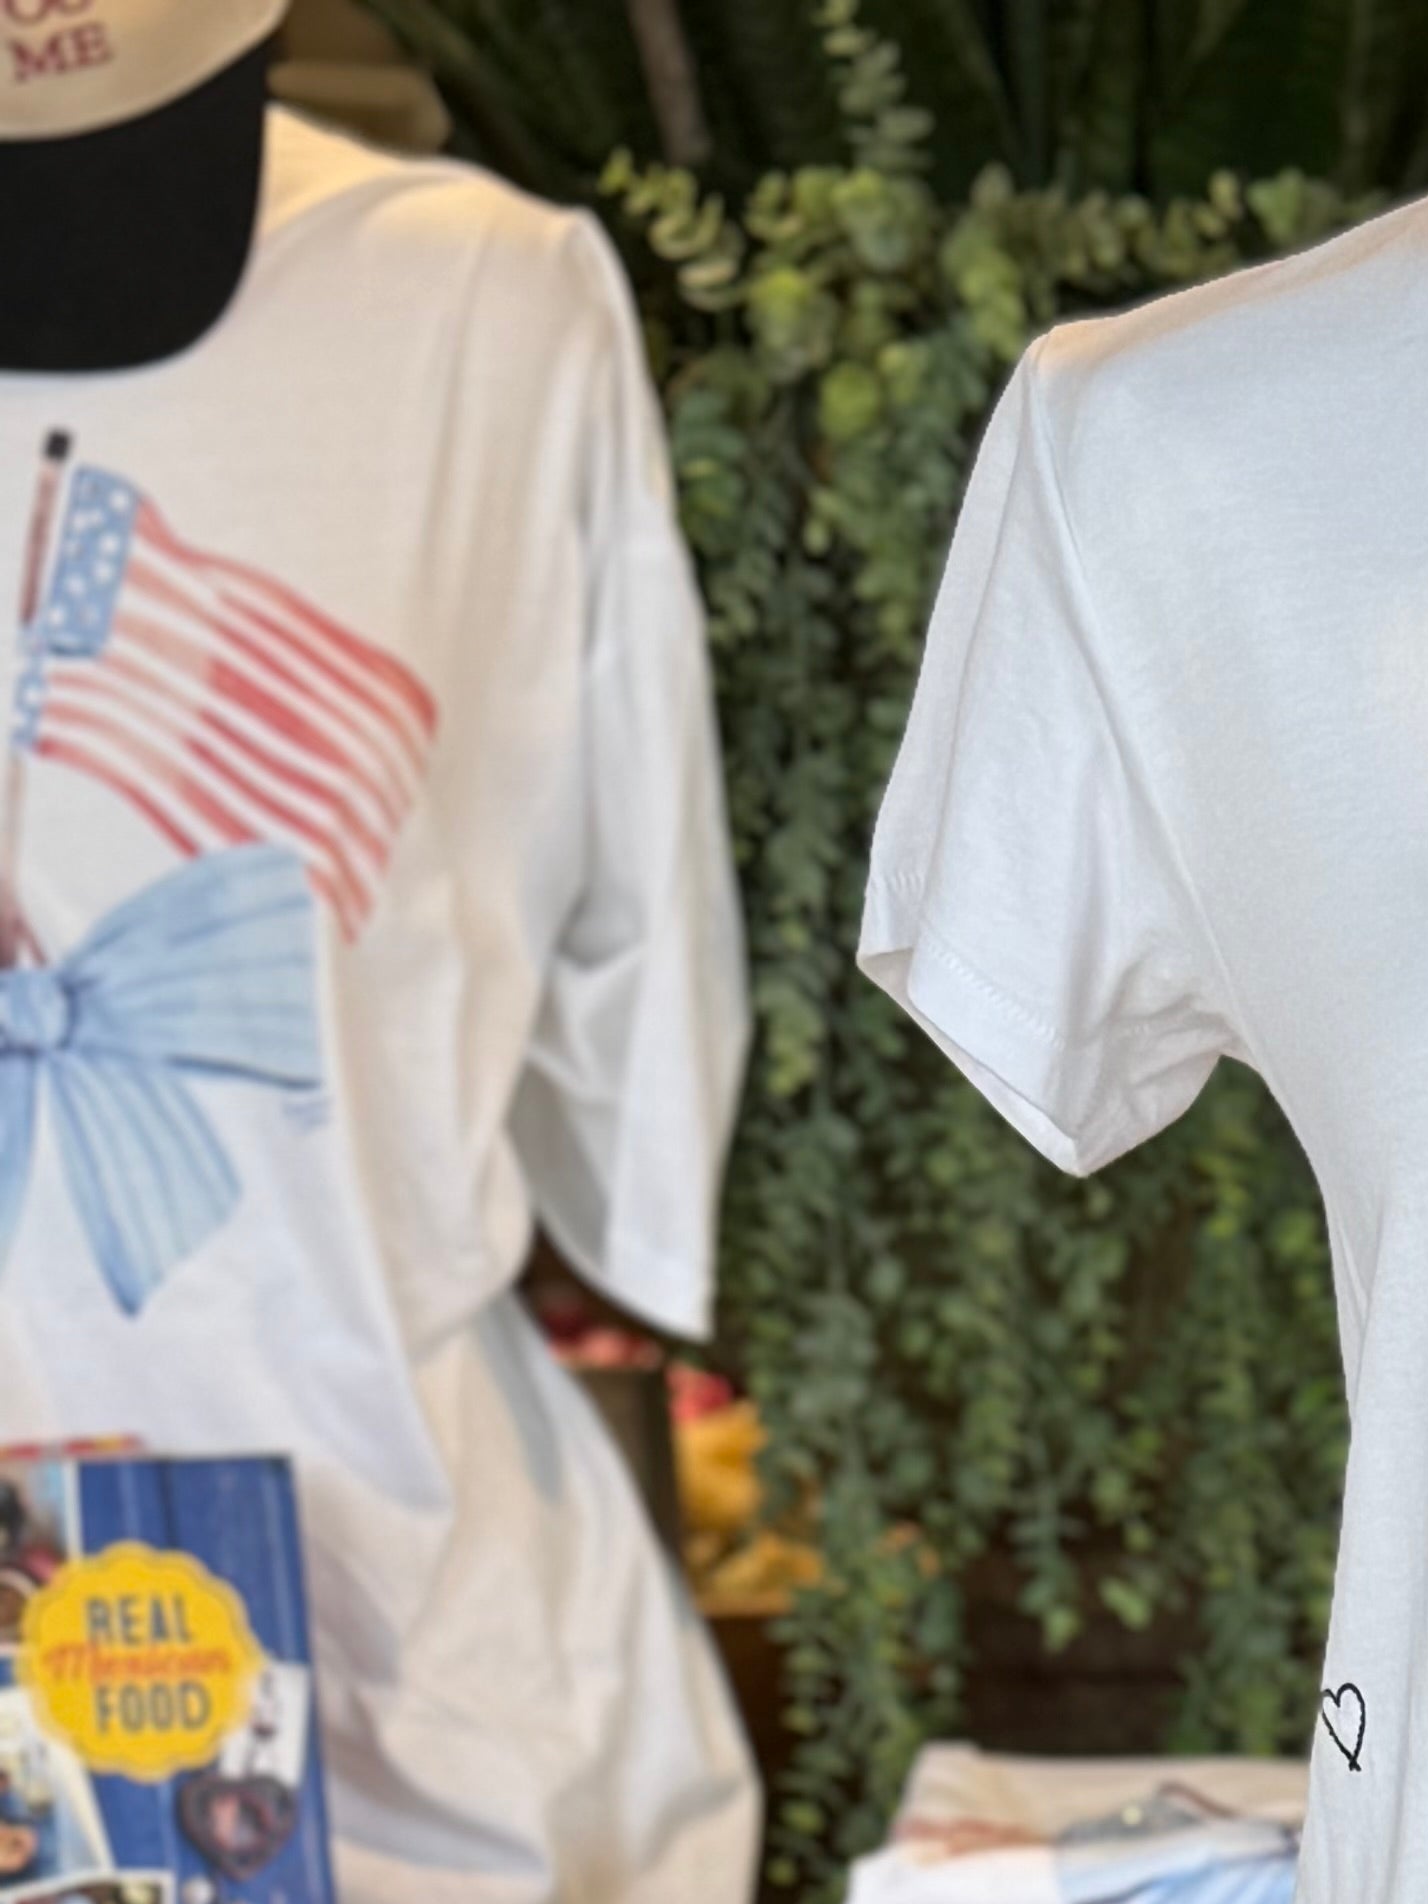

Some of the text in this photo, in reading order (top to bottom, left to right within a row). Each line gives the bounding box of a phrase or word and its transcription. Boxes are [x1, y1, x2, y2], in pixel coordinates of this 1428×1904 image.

[11, 21, 113, 82] ME
[86, 1594, 193, 1646] REAL
[95, 1680, 212, 1736] FOOD
